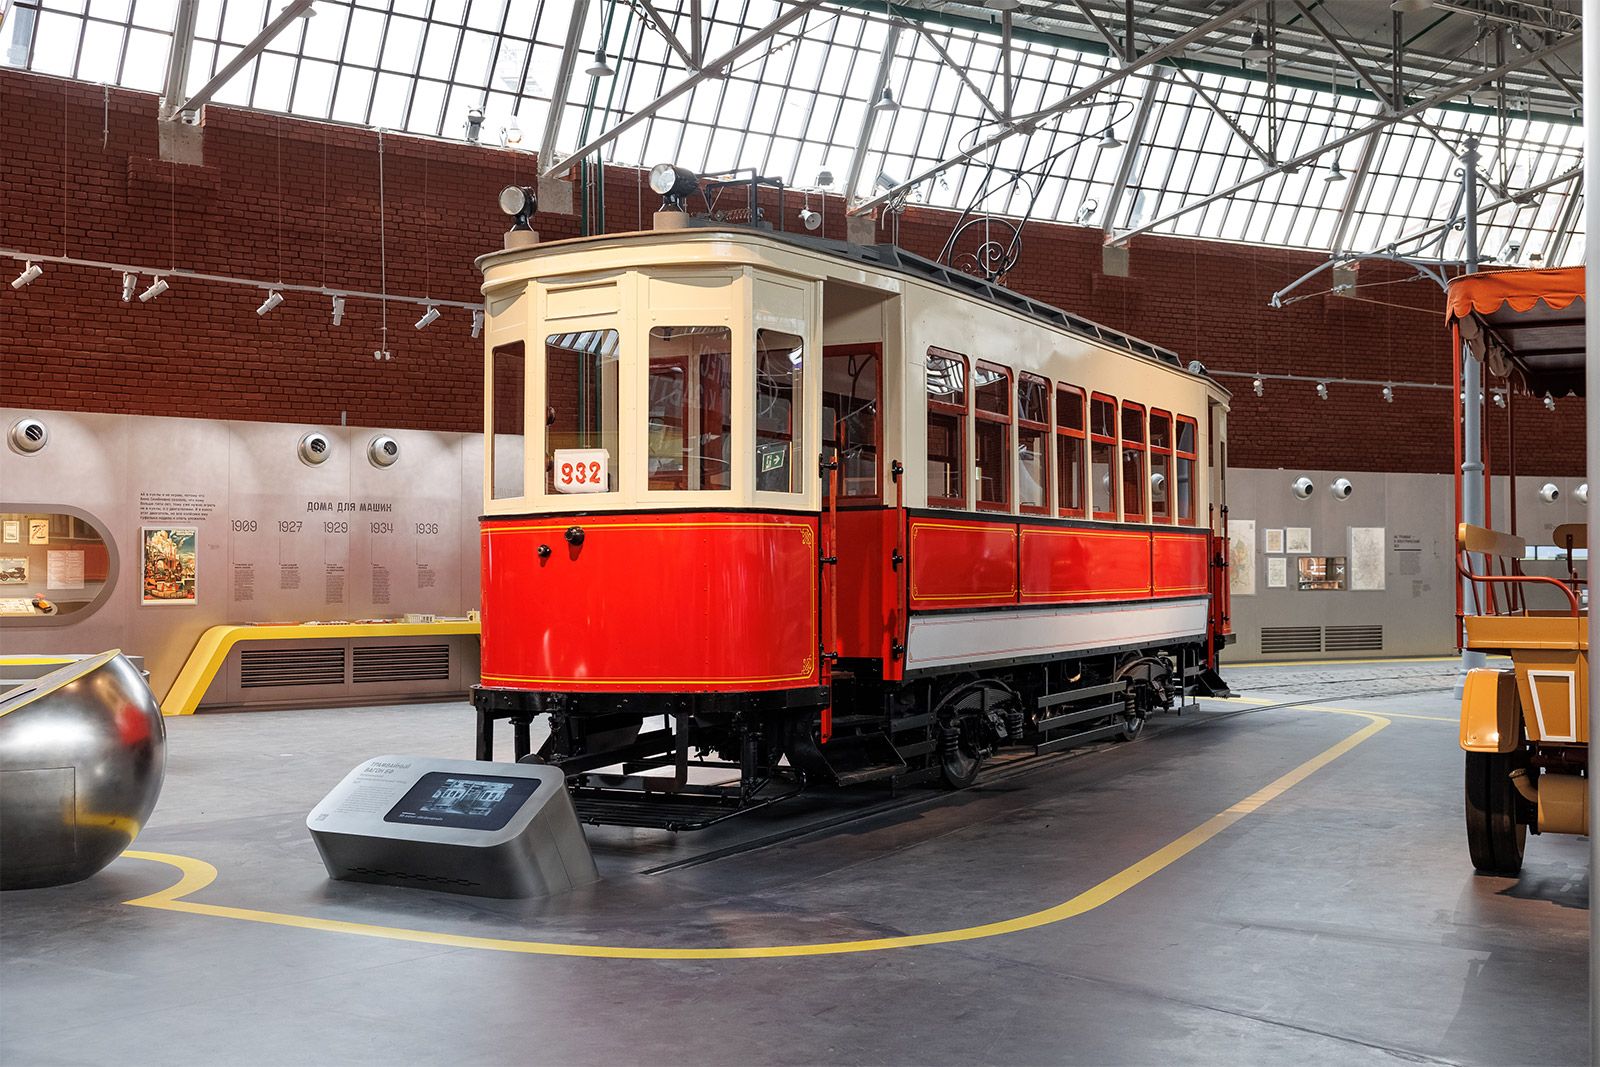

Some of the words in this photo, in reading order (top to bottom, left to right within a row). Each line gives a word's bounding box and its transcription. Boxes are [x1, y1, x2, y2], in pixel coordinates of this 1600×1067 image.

[561, 461, 601, 485] 932
[306, 502, 333, 512] ДОМА
[337, 502, 356, 513] ДЛЯ
[360, 502, 392, 512] МАШИН
[231, 520, 258, 532] 1909
[278, 520, 303, 532] 1927
[323, 521, 348, 534] 1929
[370, 522, 394, 534] 1934
[415, 522, 439, 535] 1936
